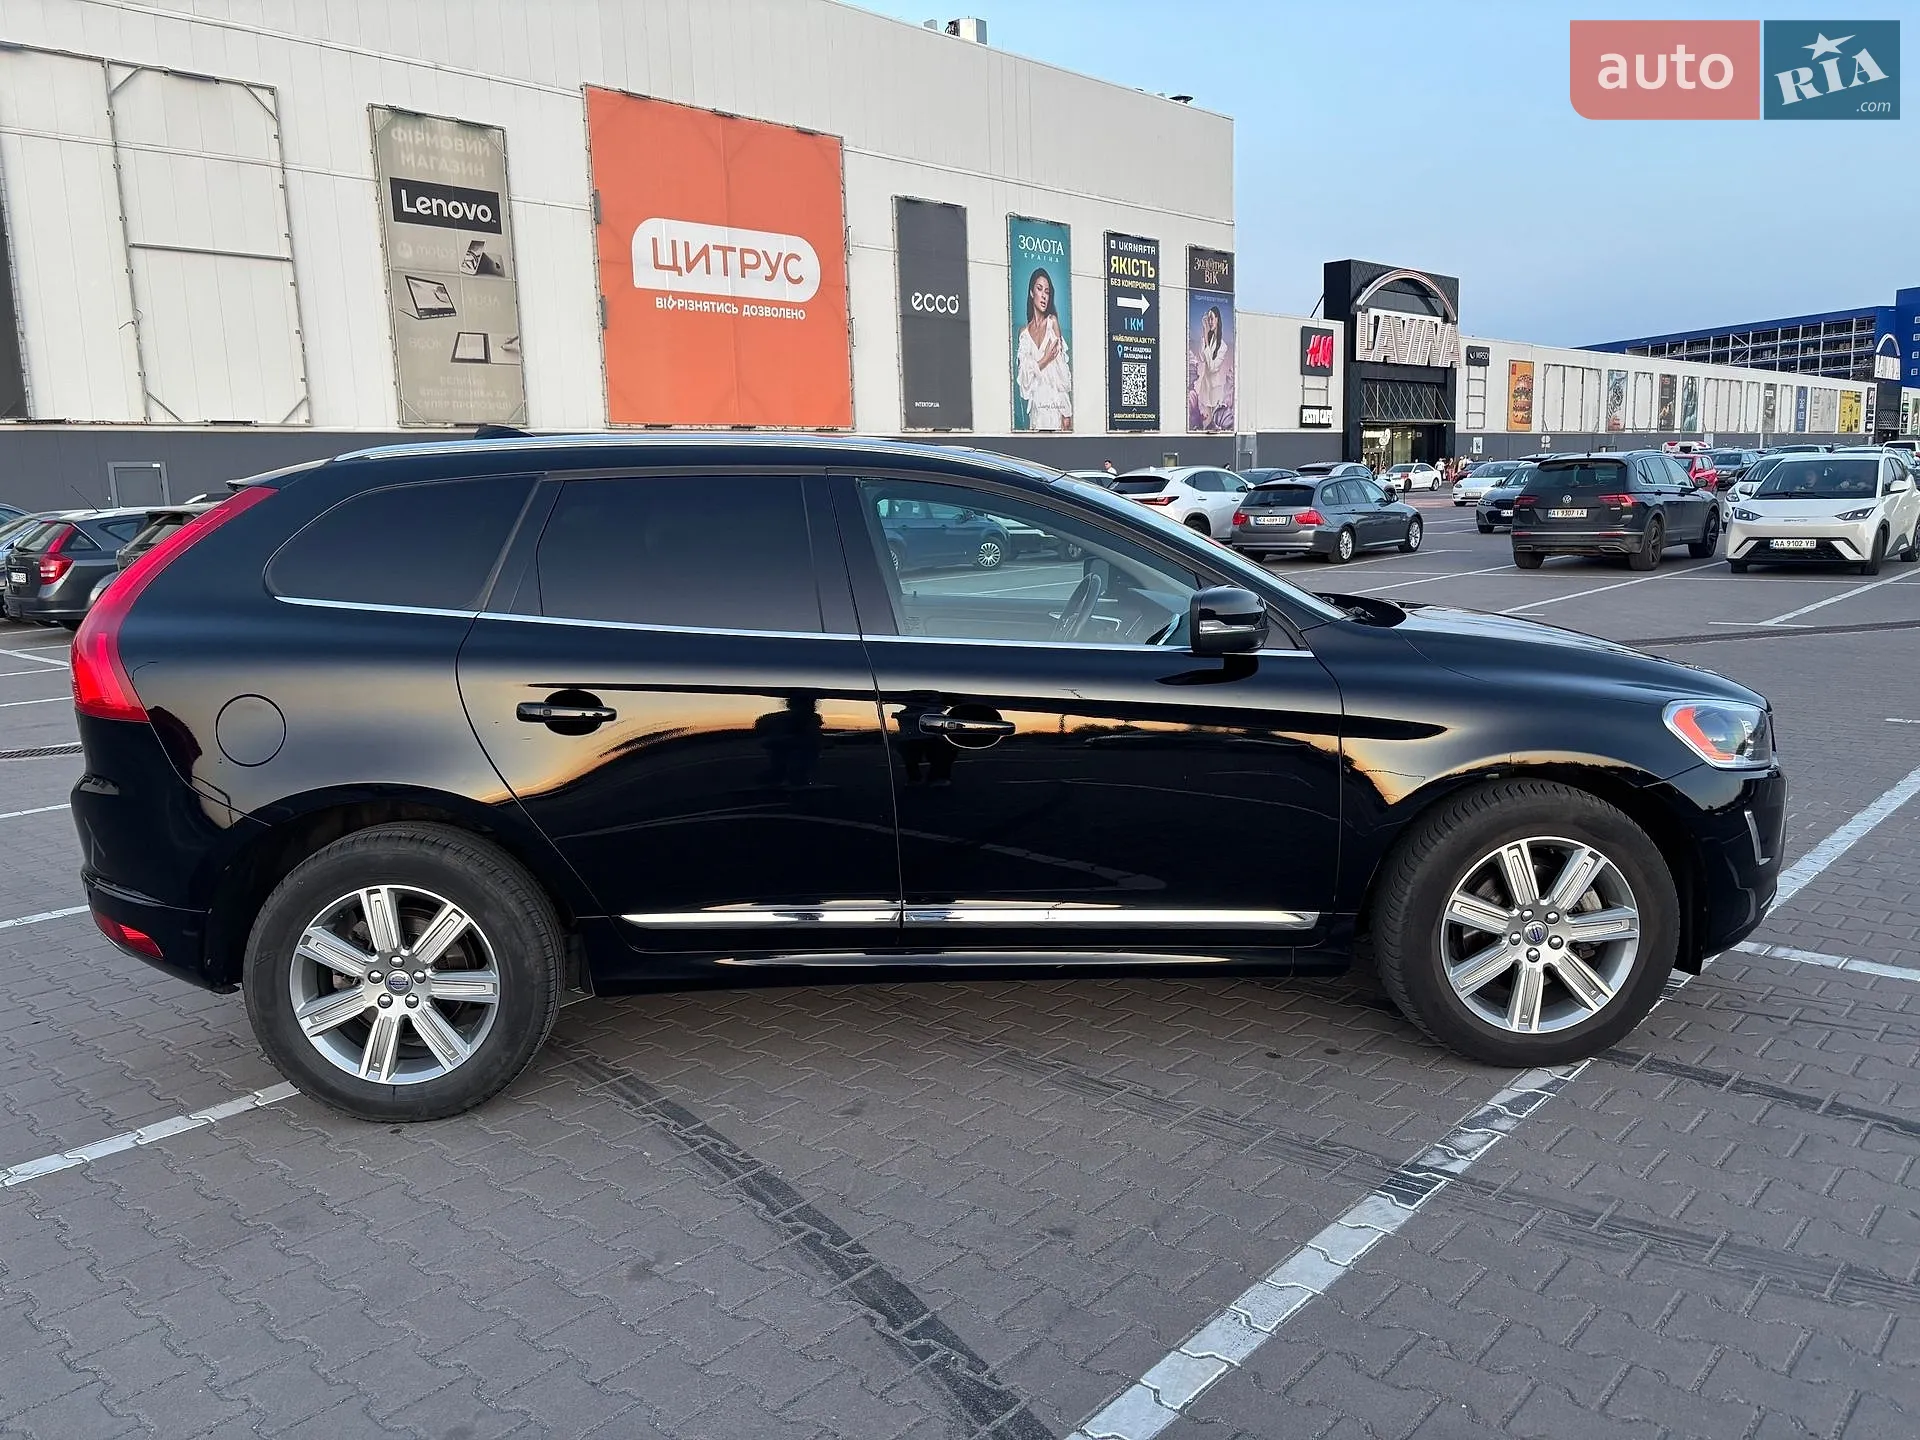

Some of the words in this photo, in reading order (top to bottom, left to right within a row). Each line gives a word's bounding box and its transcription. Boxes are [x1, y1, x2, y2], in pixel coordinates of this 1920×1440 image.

[391, 126, 490, 158] ФІРМОВИЙ
[400, 150, 486, 178] МАГАЗИН
[400, 189, 492, 223] Lenovo
[1018, 234, 1065, 256] ЗОЛОТА
[651, 236, 804, 285] ЦИТРУС
[1110, 255, 1156, 279] ЯКІСТЬ
[742, 305, 806, 320] ДОЗВОЛЕНО
[911, 292, 959, 314] ecco
[1355, 311, 1461, 369] LAVINA
